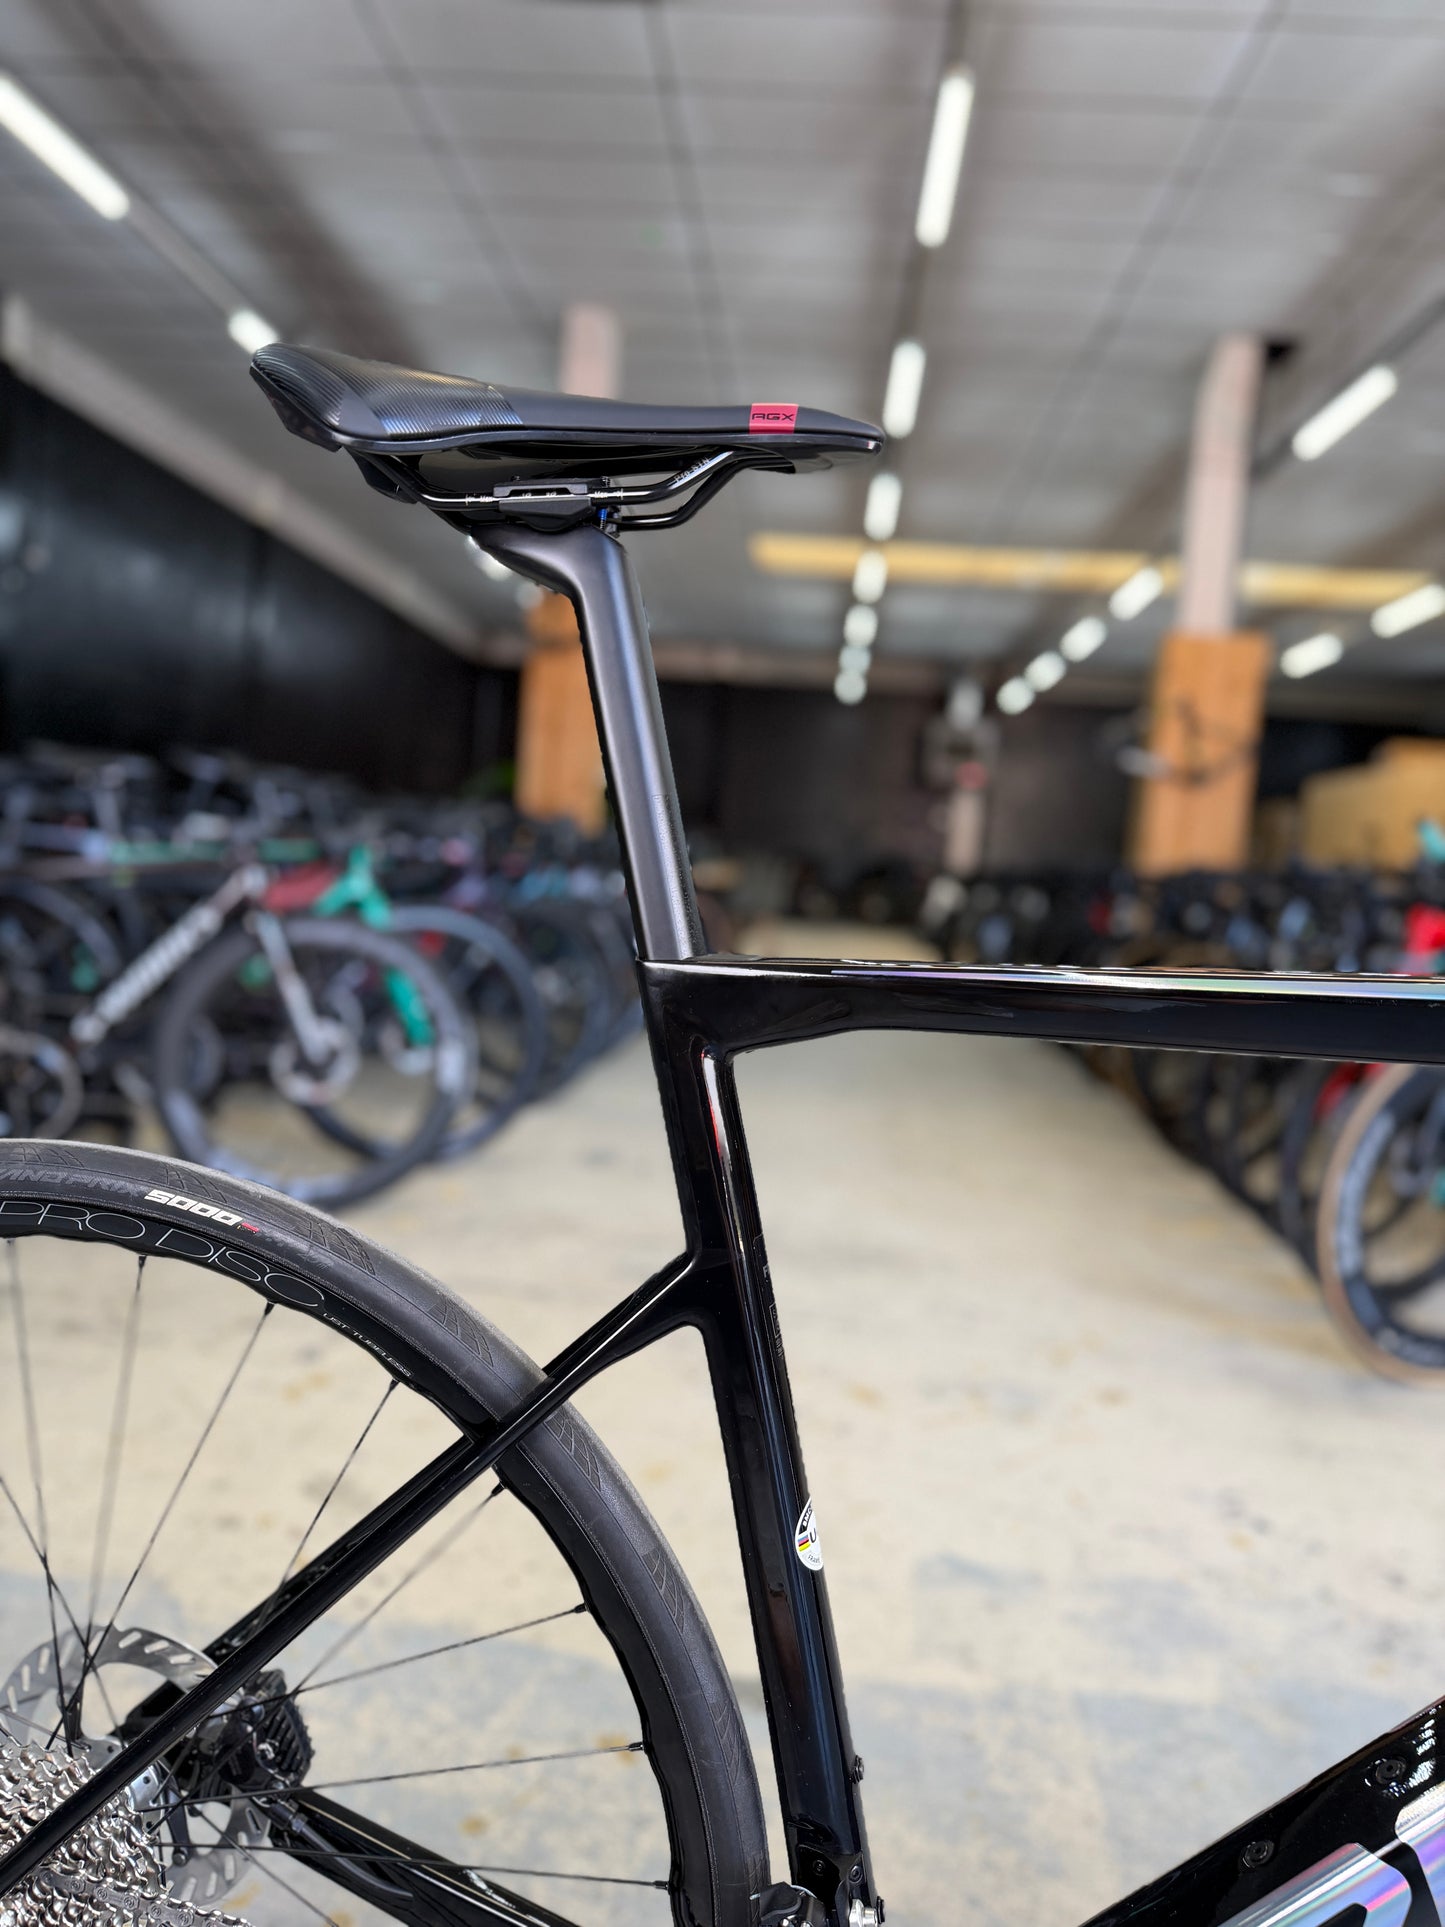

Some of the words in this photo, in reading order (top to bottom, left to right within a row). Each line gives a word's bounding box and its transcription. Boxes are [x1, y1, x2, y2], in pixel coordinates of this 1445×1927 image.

[752, 412, 794, 421] AGX
[144, 1189, 243, 1226] 5000
[0, 1201, 146, 1239] PRO
[155, 1228, 325, 1307] DISC
[353, 1329, 412, 1377] TUBELESS
